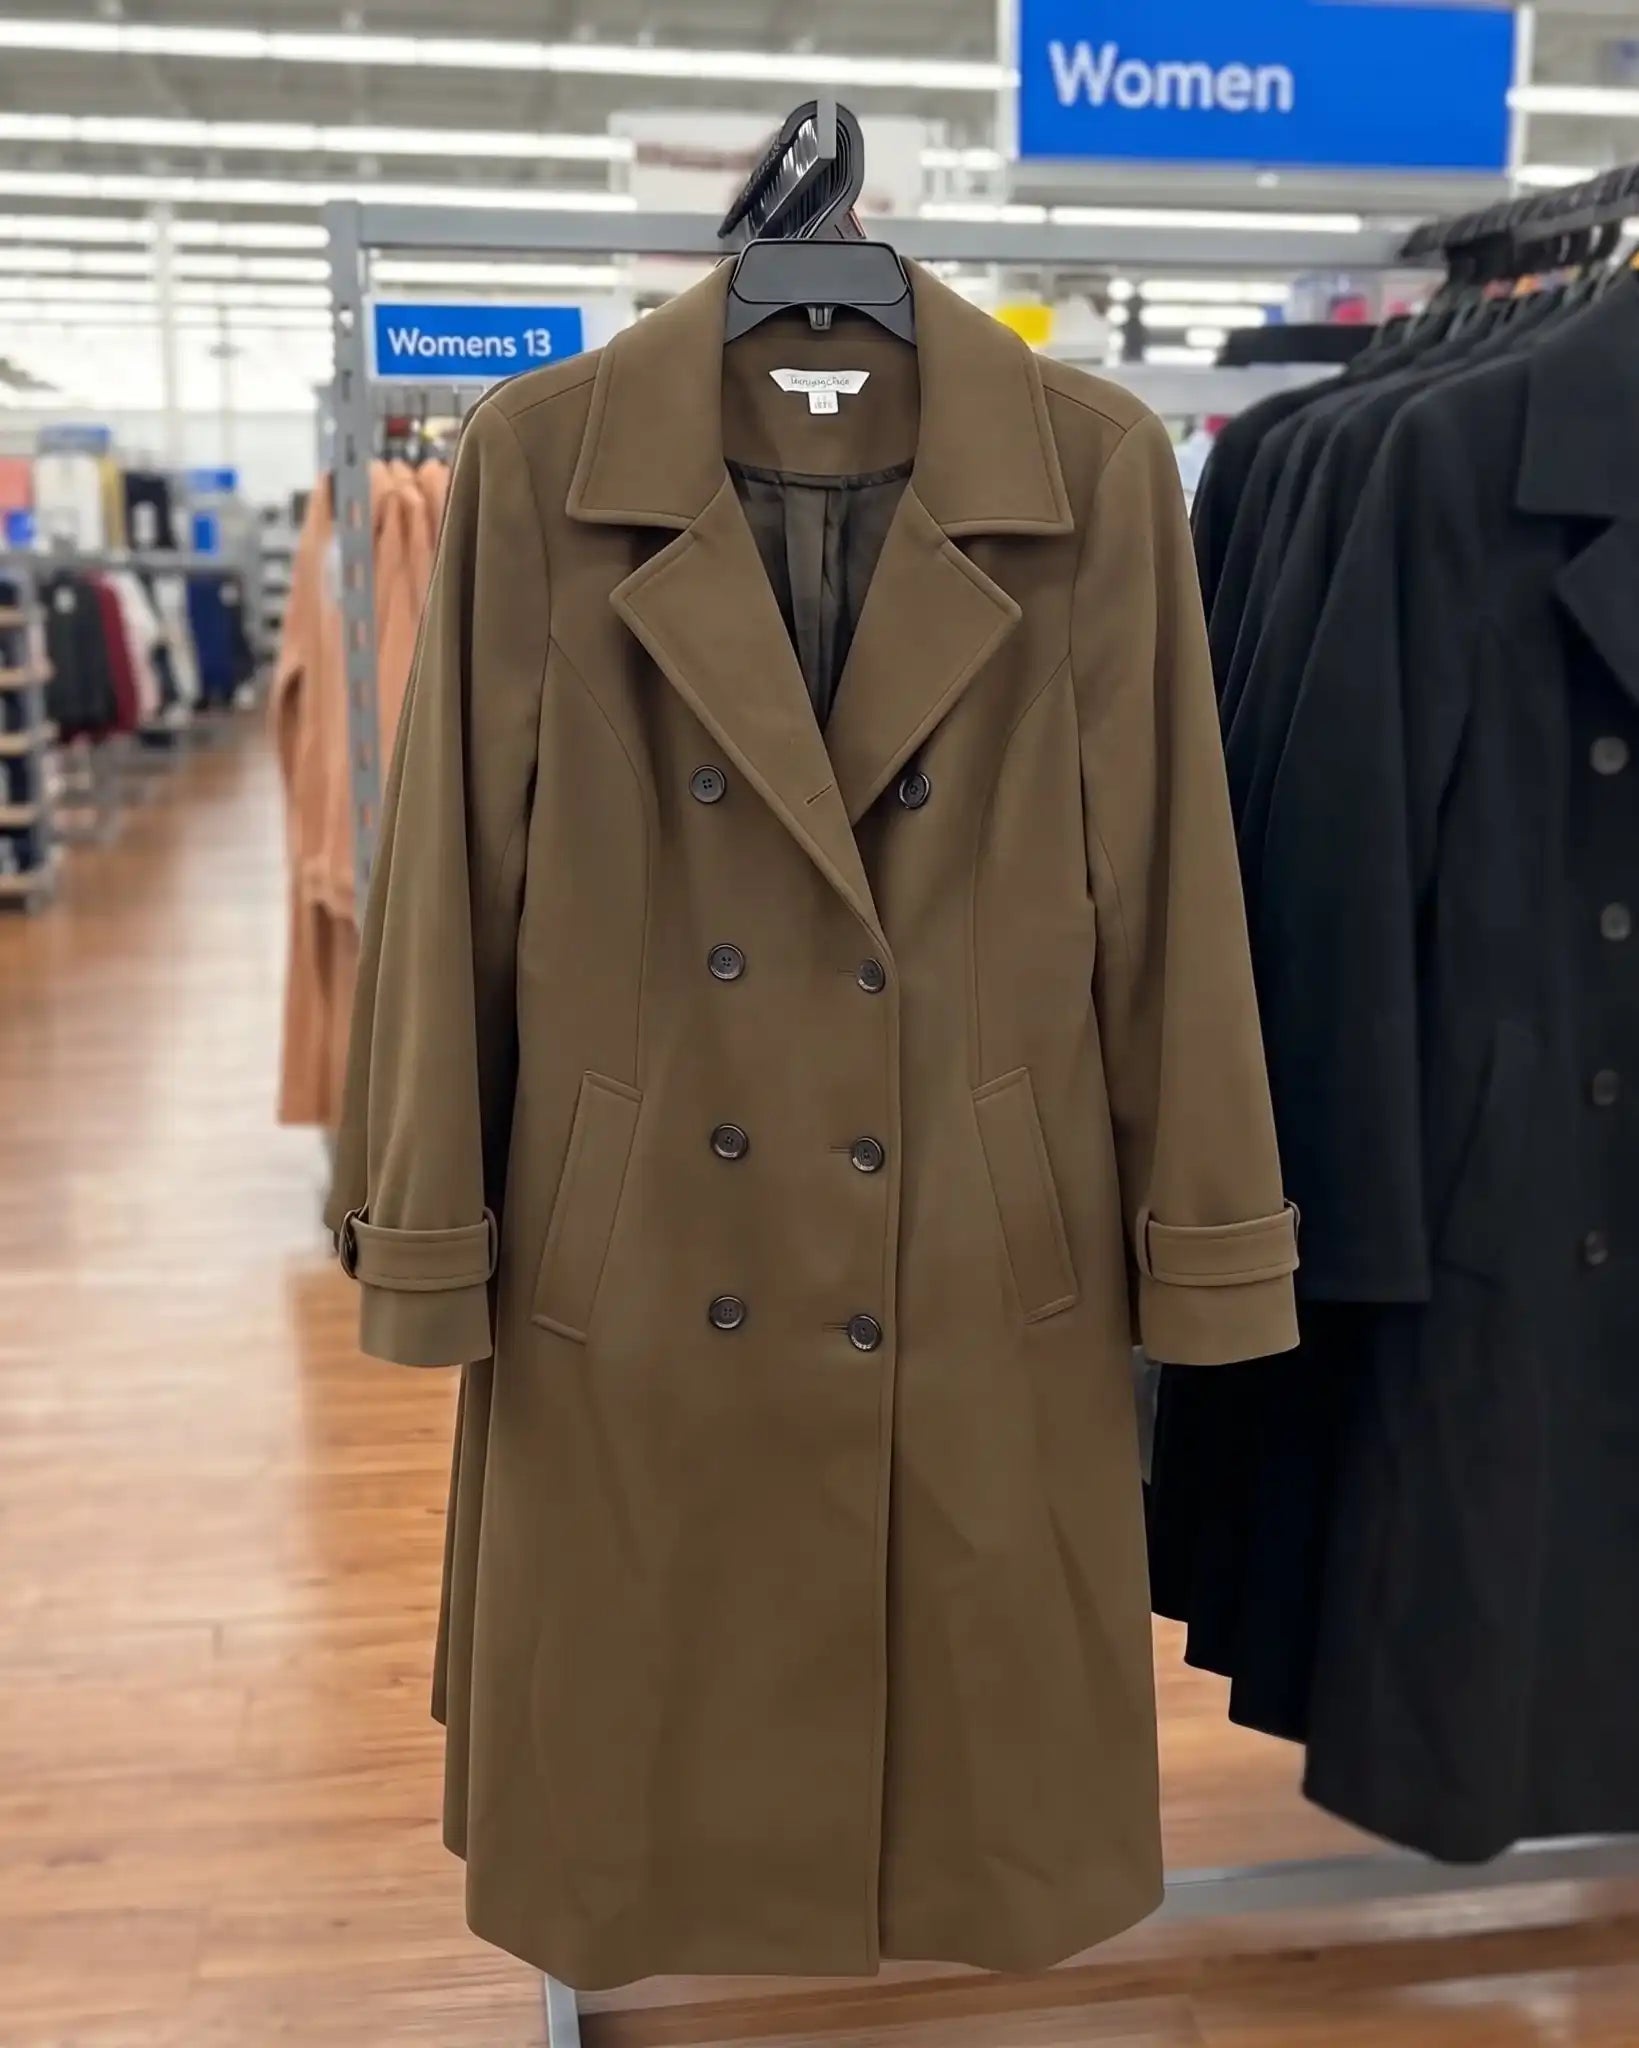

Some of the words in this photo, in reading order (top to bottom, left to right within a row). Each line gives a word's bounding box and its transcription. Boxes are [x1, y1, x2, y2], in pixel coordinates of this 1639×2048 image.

[1049, 41, 1294, 112] Women
[387, 327, 517, 357] Womens
[523, 328, 552, 357] 13
